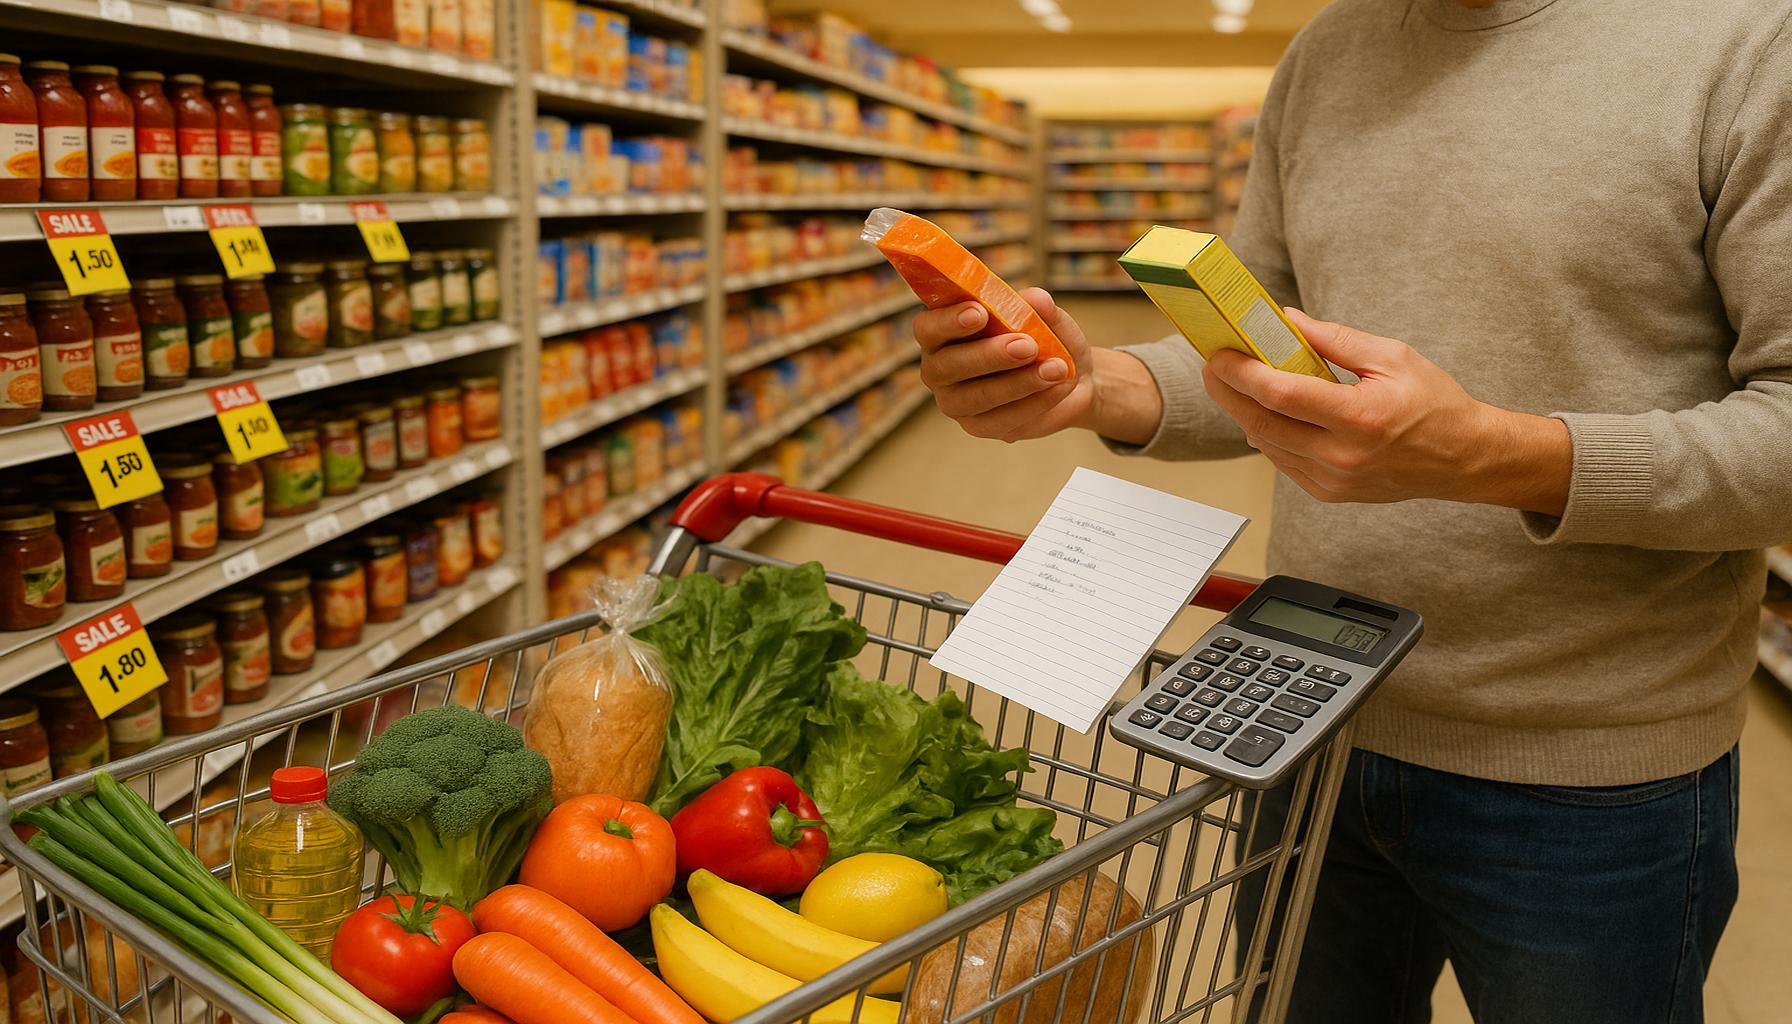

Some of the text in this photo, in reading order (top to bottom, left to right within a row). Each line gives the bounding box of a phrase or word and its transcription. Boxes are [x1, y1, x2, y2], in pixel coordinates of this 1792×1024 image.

[48, 213, 97, 234] SALE
[69, 248, 114, 279] 1.50
[77, 418, 129, 447] SALE
[100, 451, 143, 489] 1.50
[74, 613, 132, 653] SALE
[98, 647, 147, 694] 1.80
